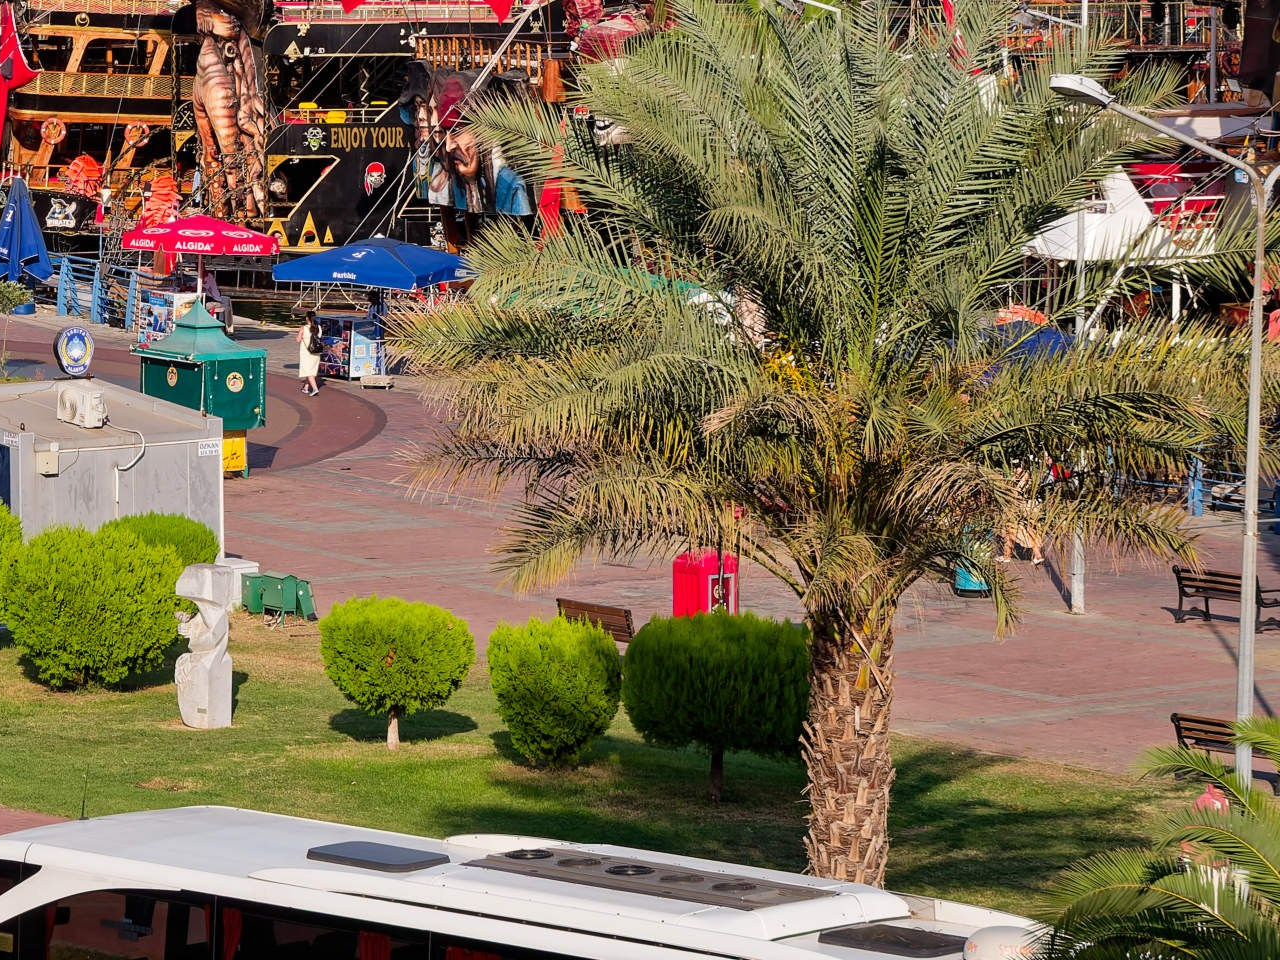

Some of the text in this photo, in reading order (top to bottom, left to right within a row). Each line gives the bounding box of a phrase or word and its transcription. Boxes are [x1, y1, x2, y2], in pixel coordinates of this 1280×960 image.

[330, 127, 404, 152] ENJOY YOUR
[130, 239, 154, 247] ALGIDA
[175, 242, 211, 251] ALGIDA
[233, 244, 261, 252] ALGIDA
